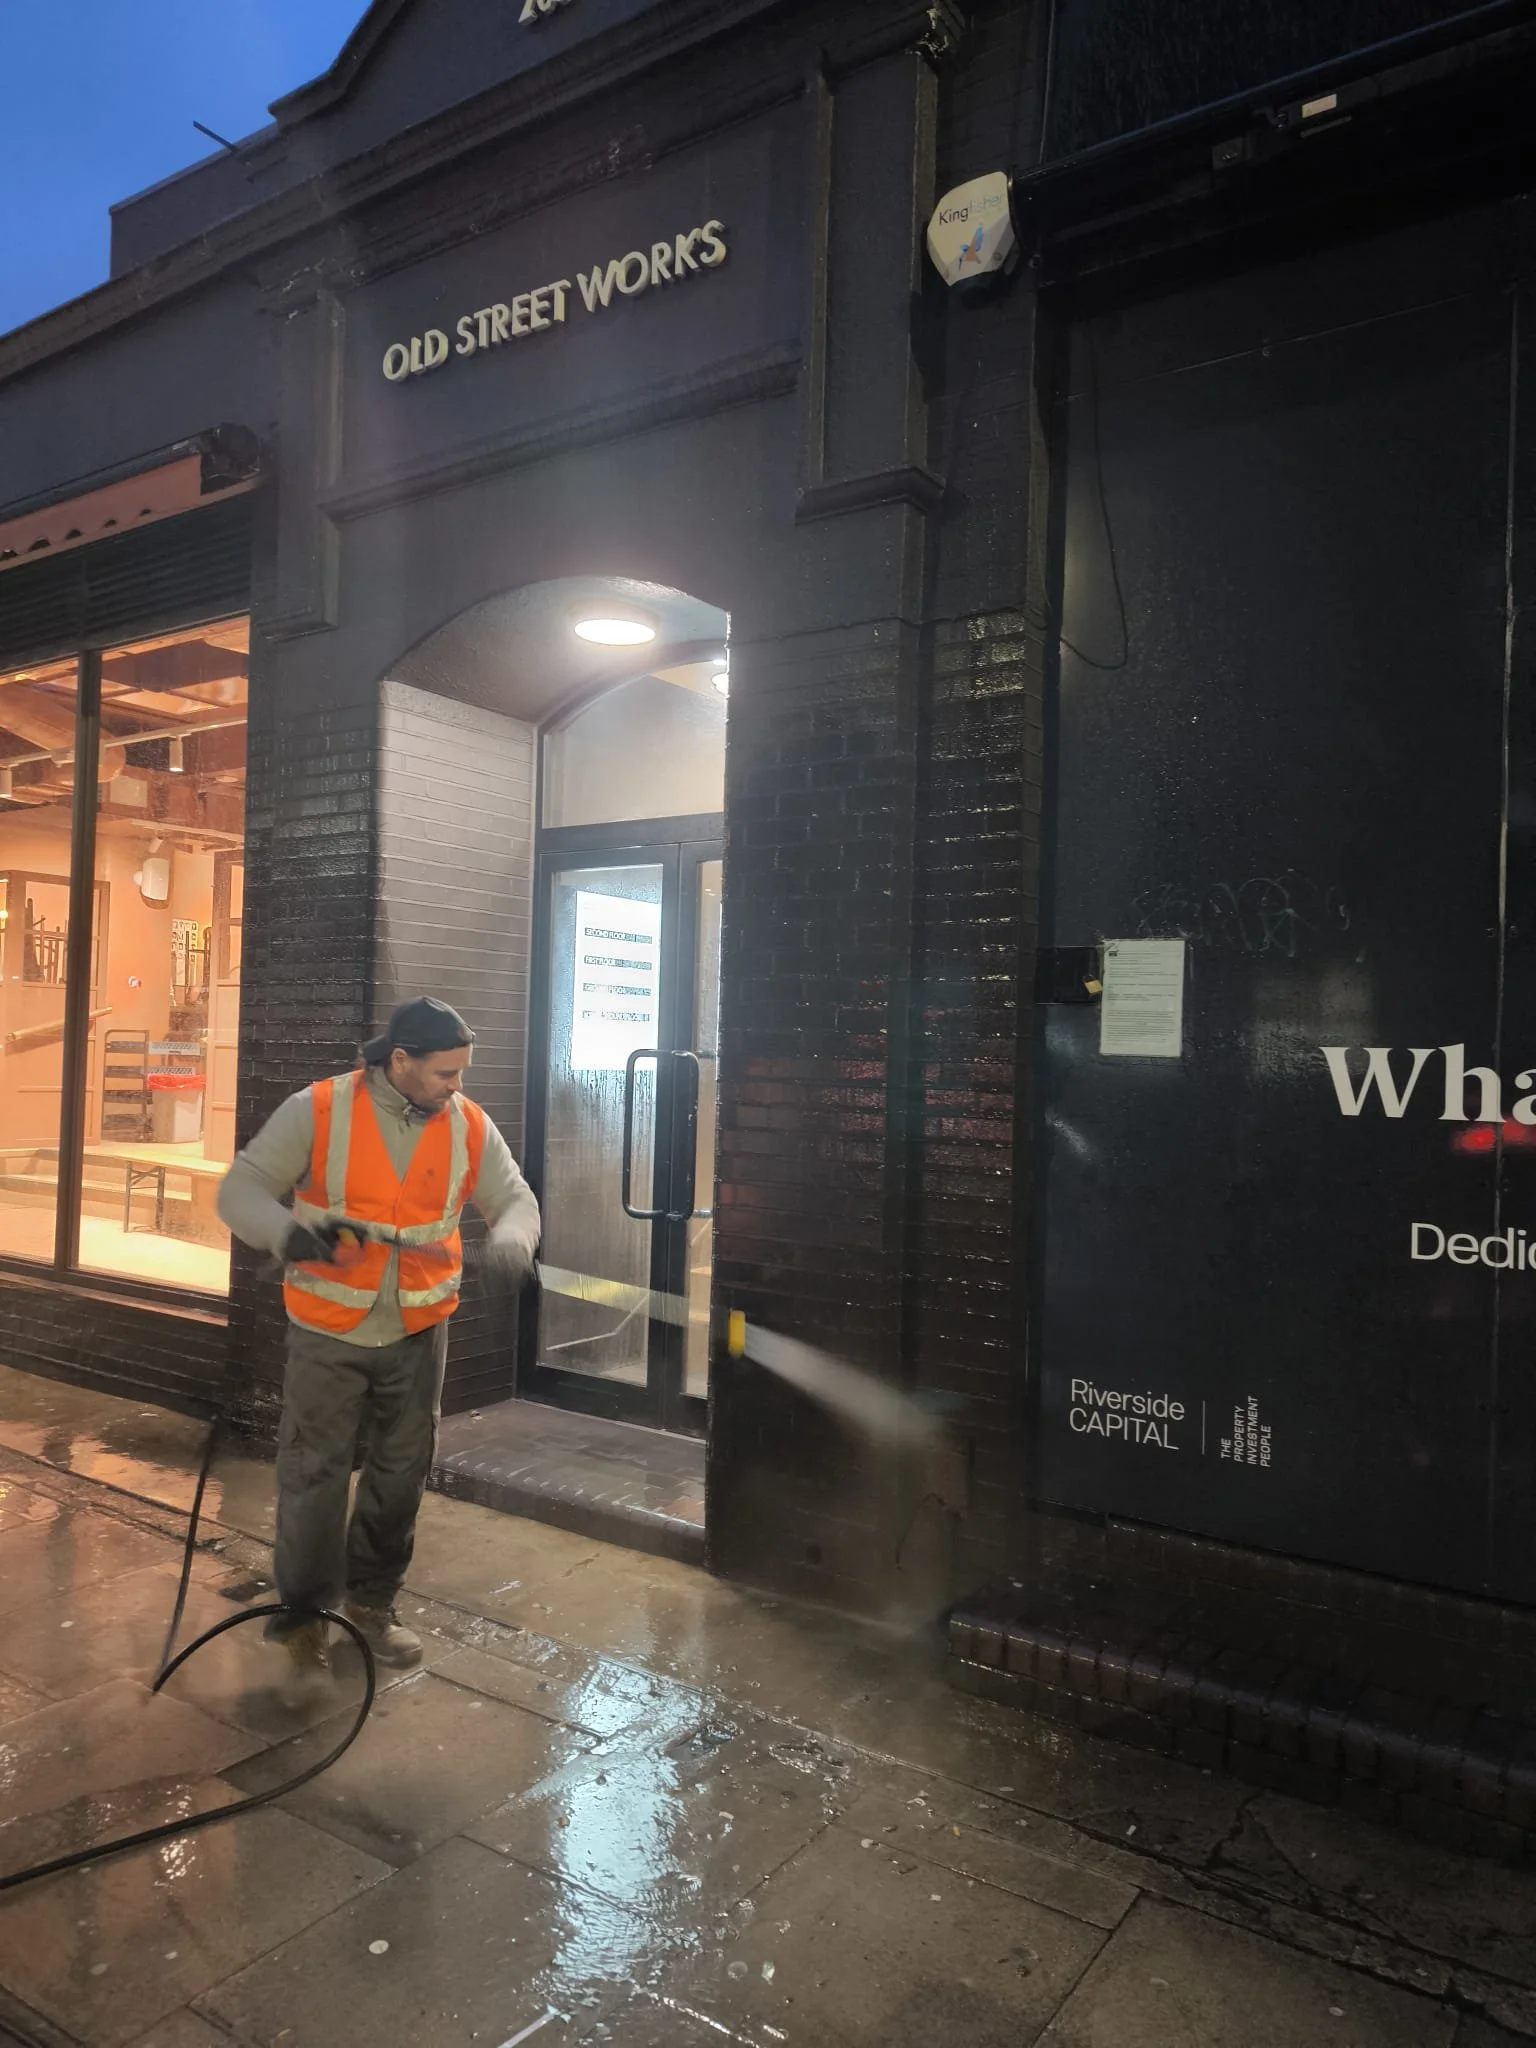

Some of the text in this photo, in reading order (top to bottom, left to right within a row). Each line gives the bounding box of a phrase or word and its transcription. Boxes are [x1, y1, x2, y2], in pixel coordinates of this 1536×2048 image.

[383, 219, 728, 382] OLD STREET WORKS
[1411, 1222, 1536, 1271] Dedi
[1071, 1378, 1185, 1421] Riverside
[1069, 1407, 1180, 1450] CAPITAL
[1220, 1438, 1231, 1459] THE
[1233, 1405, 1246, 1463] PROPERTY
[1247, 1396, 1259, 1465] INVESTMENT
[1260, 1425, 1272, 1467] PEOPLE
